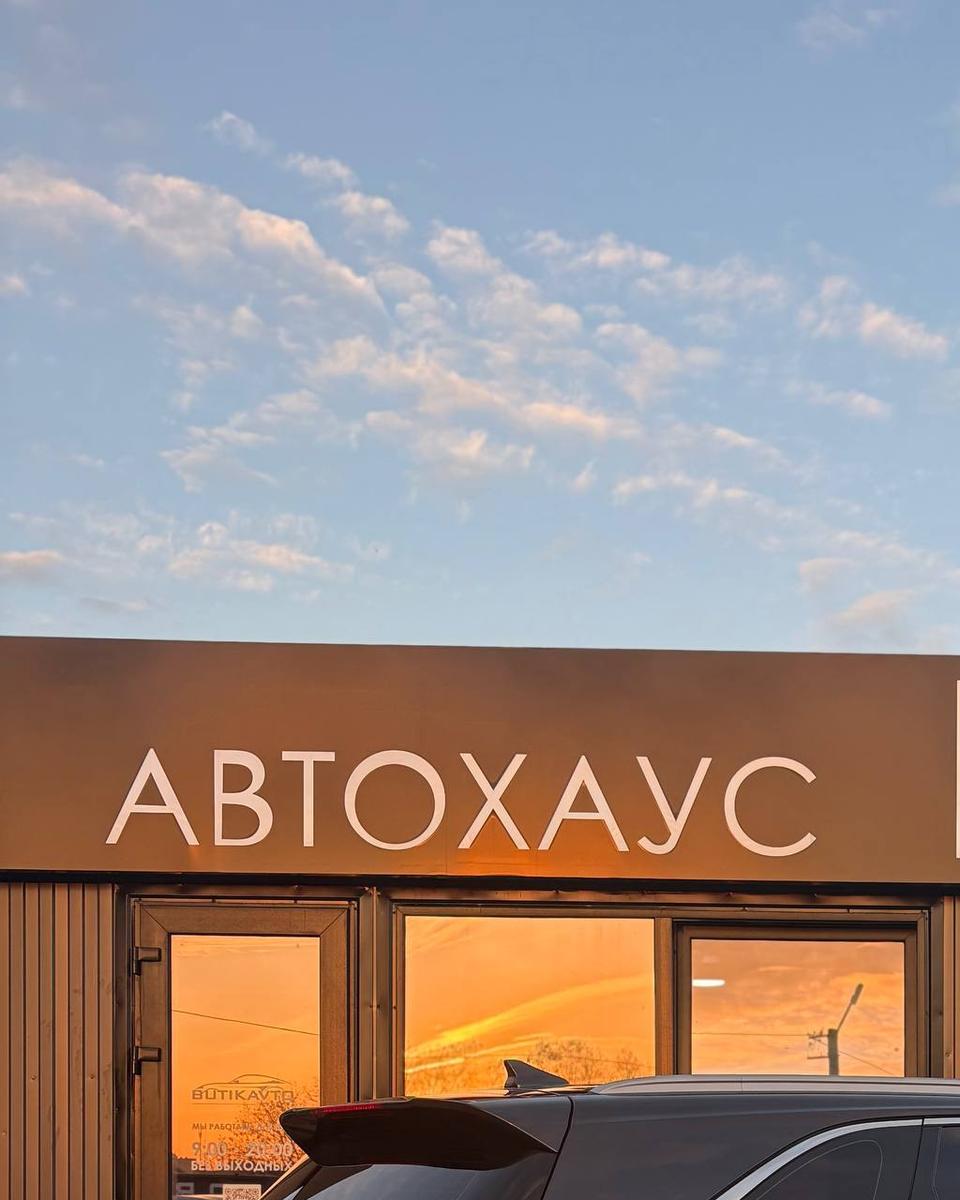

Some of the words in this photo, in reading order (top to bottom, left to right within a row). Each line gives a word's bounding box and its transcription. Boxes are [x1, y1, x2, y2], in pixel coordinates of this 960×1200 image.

[105, 747, 817, 858] АВТОХАУС
[191, 1090, 295, 1101] BUTIKAVTO
[216, 1161, 293, 1172] ВЫХОДНЫХ
